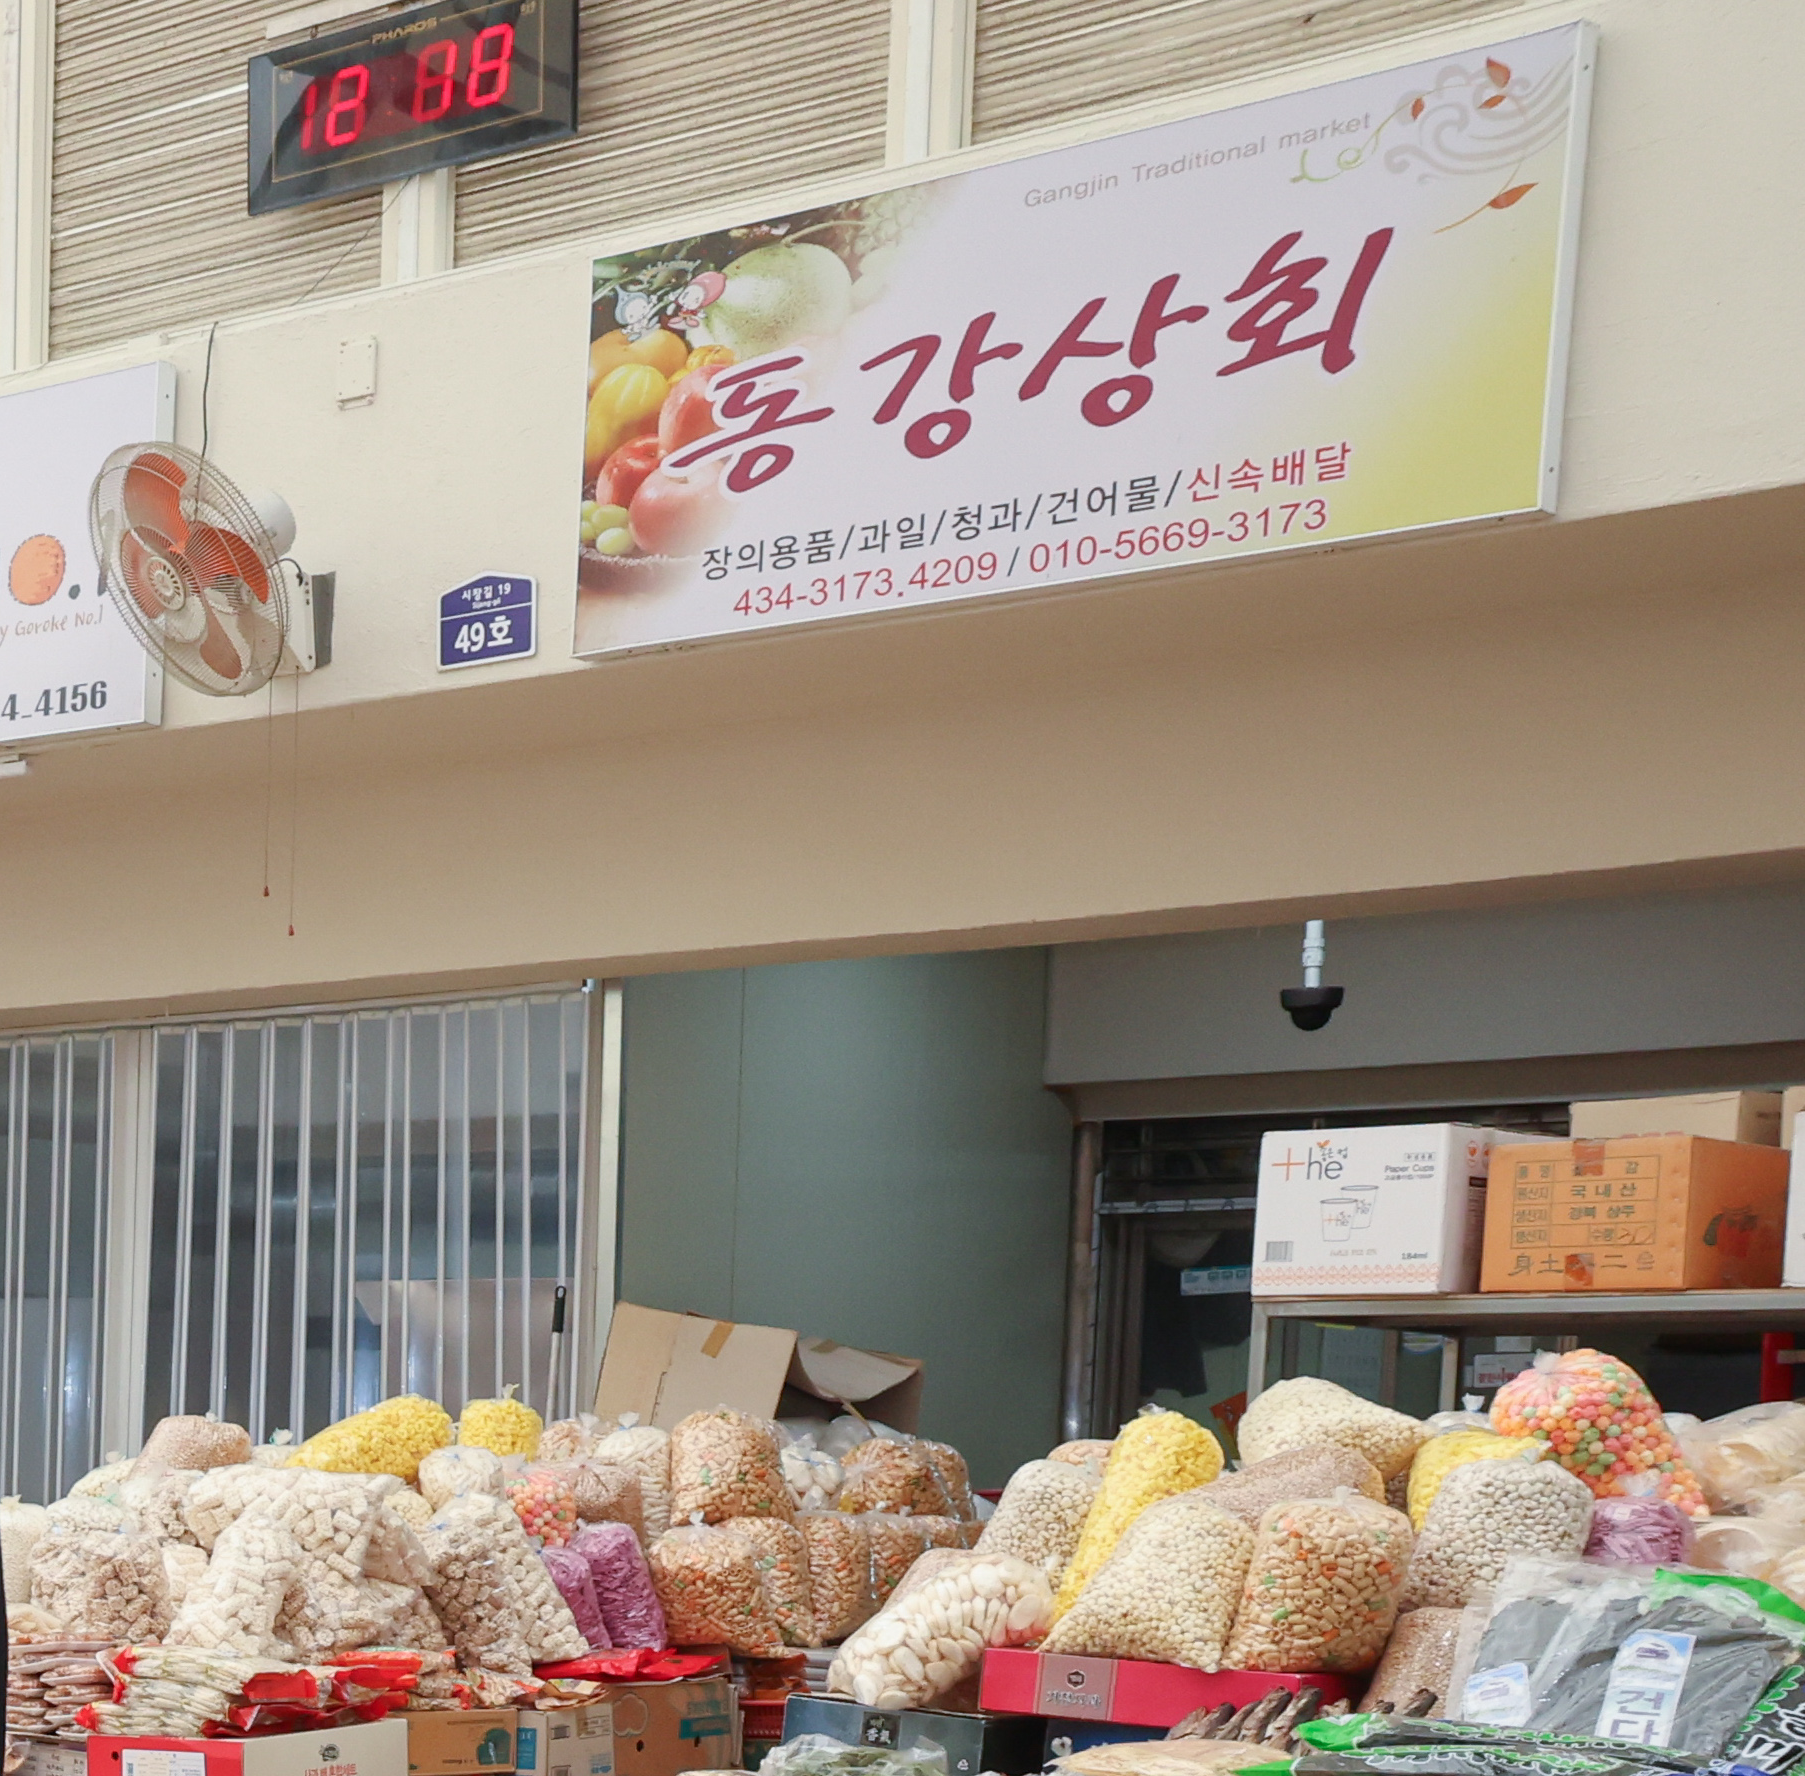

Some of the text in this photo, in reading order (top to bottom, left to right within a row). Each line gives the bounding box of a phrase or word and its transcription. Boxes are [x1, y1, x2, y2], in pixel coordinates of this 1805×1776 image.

[371, 17, 437, 44] PHAROS
[1024, 111, 1371, 208] Gangjin Traditional market
[662, 224, 1397, 496] 동강상회
[701, 440, 1351, 583] 장의용품/과일/청과/건어물/신속배달
[732, 551, 997, 617] 434-3173.4209
[1028, 497, 1328, 574] 010-5669-3173
[497, 582, 512, 595] 19
[14, 614, 68, 637] Goroke
[74, 604, 104, 628] No.1
[453, 614, 514, 654] 49호
[1385, 1164, 1434, 1173] Paper Cups
